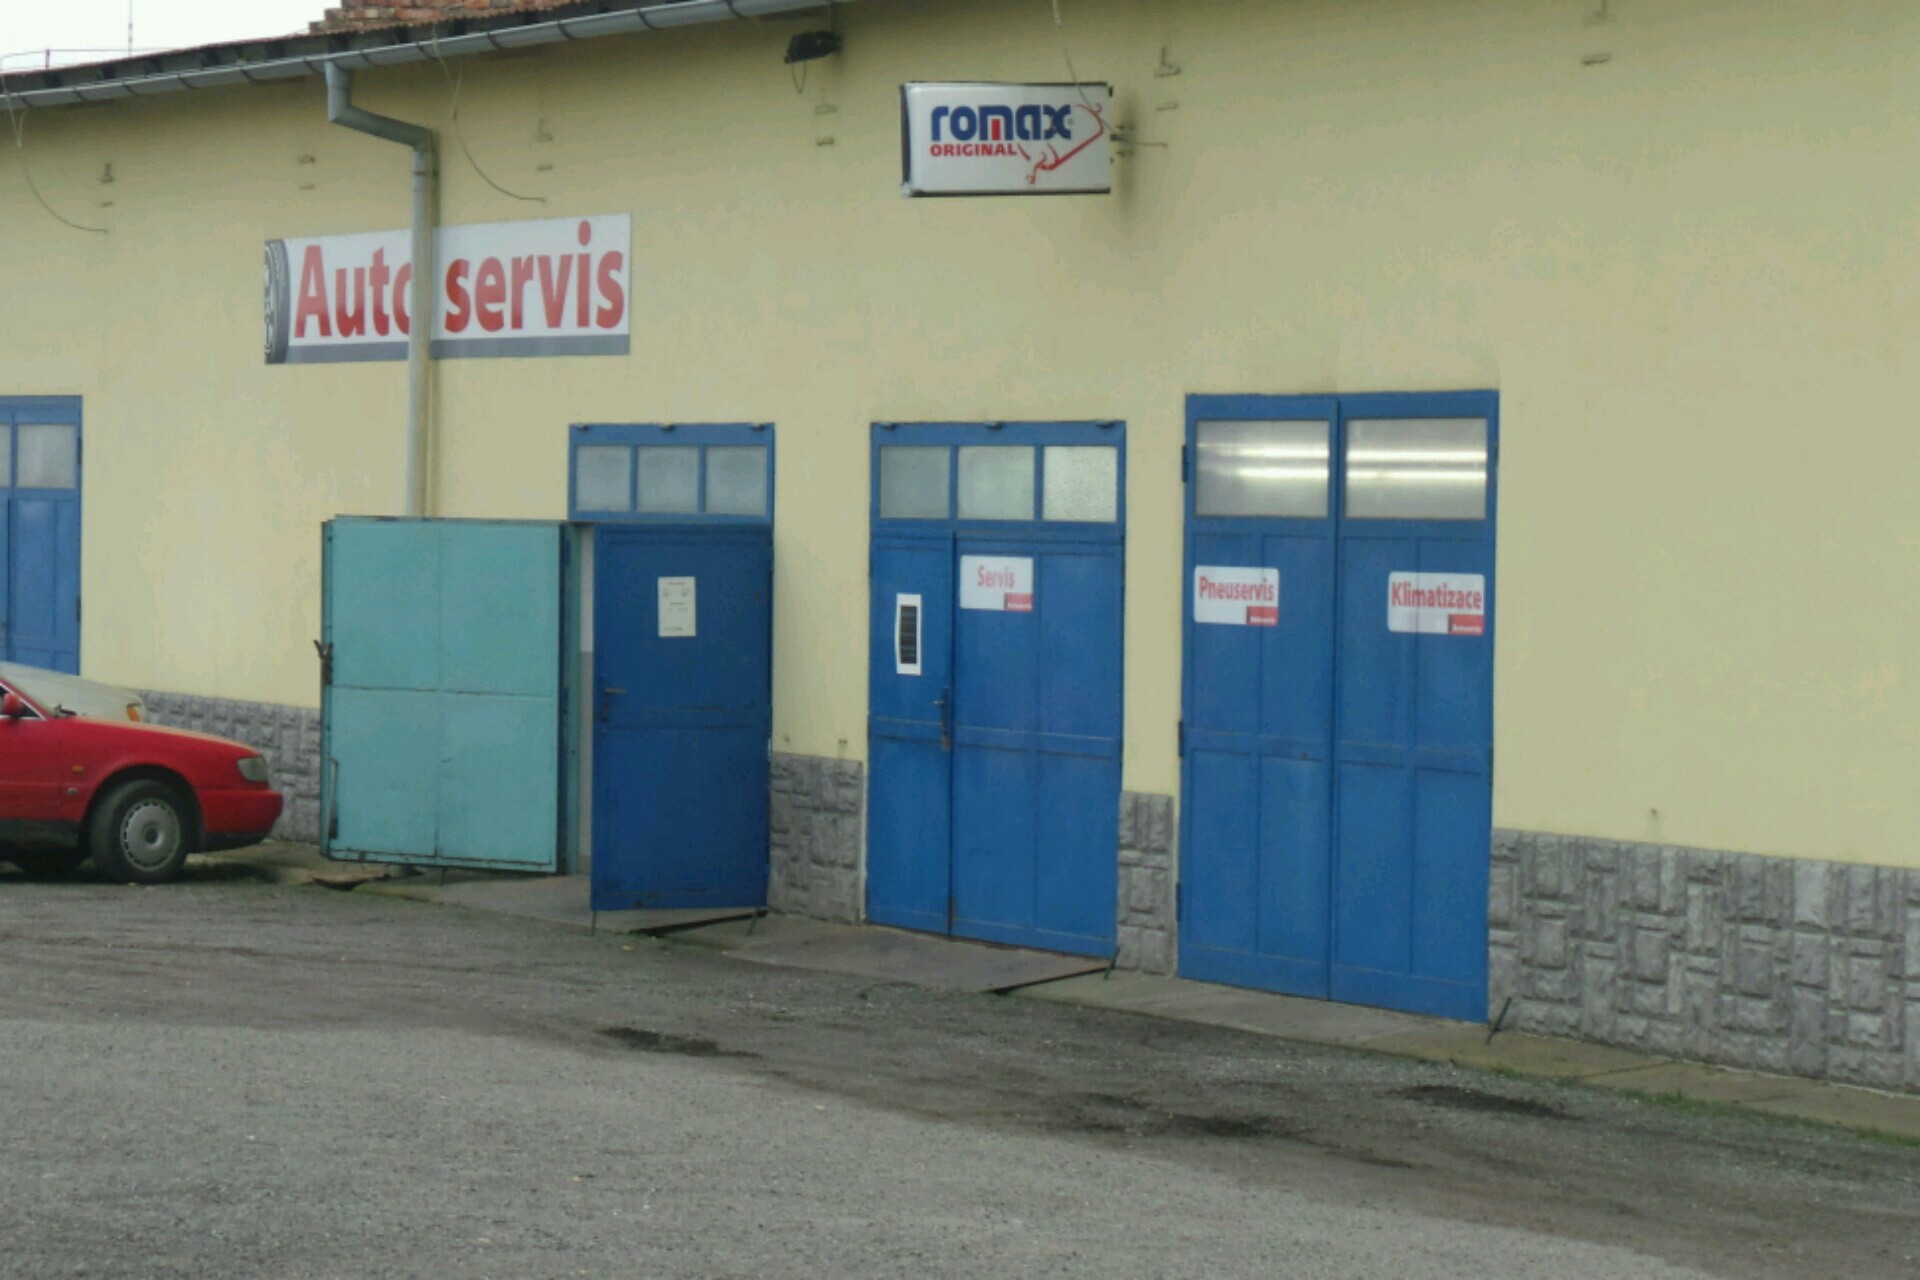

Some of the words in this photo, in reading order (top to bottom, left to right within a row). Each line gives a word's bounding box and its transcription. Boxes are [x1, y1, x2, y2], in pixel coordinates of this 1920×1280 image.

[931, 104, 1071, 141] romax
[929, 143, 1018, 157] ORIGINAL
[444, 220, 625, 333] servis
[977, 564, 1015, 588] Servis
[1199, 575, 1275, 602] Pneuservis
[1391, 581, 1482, 610] Klimatizace
